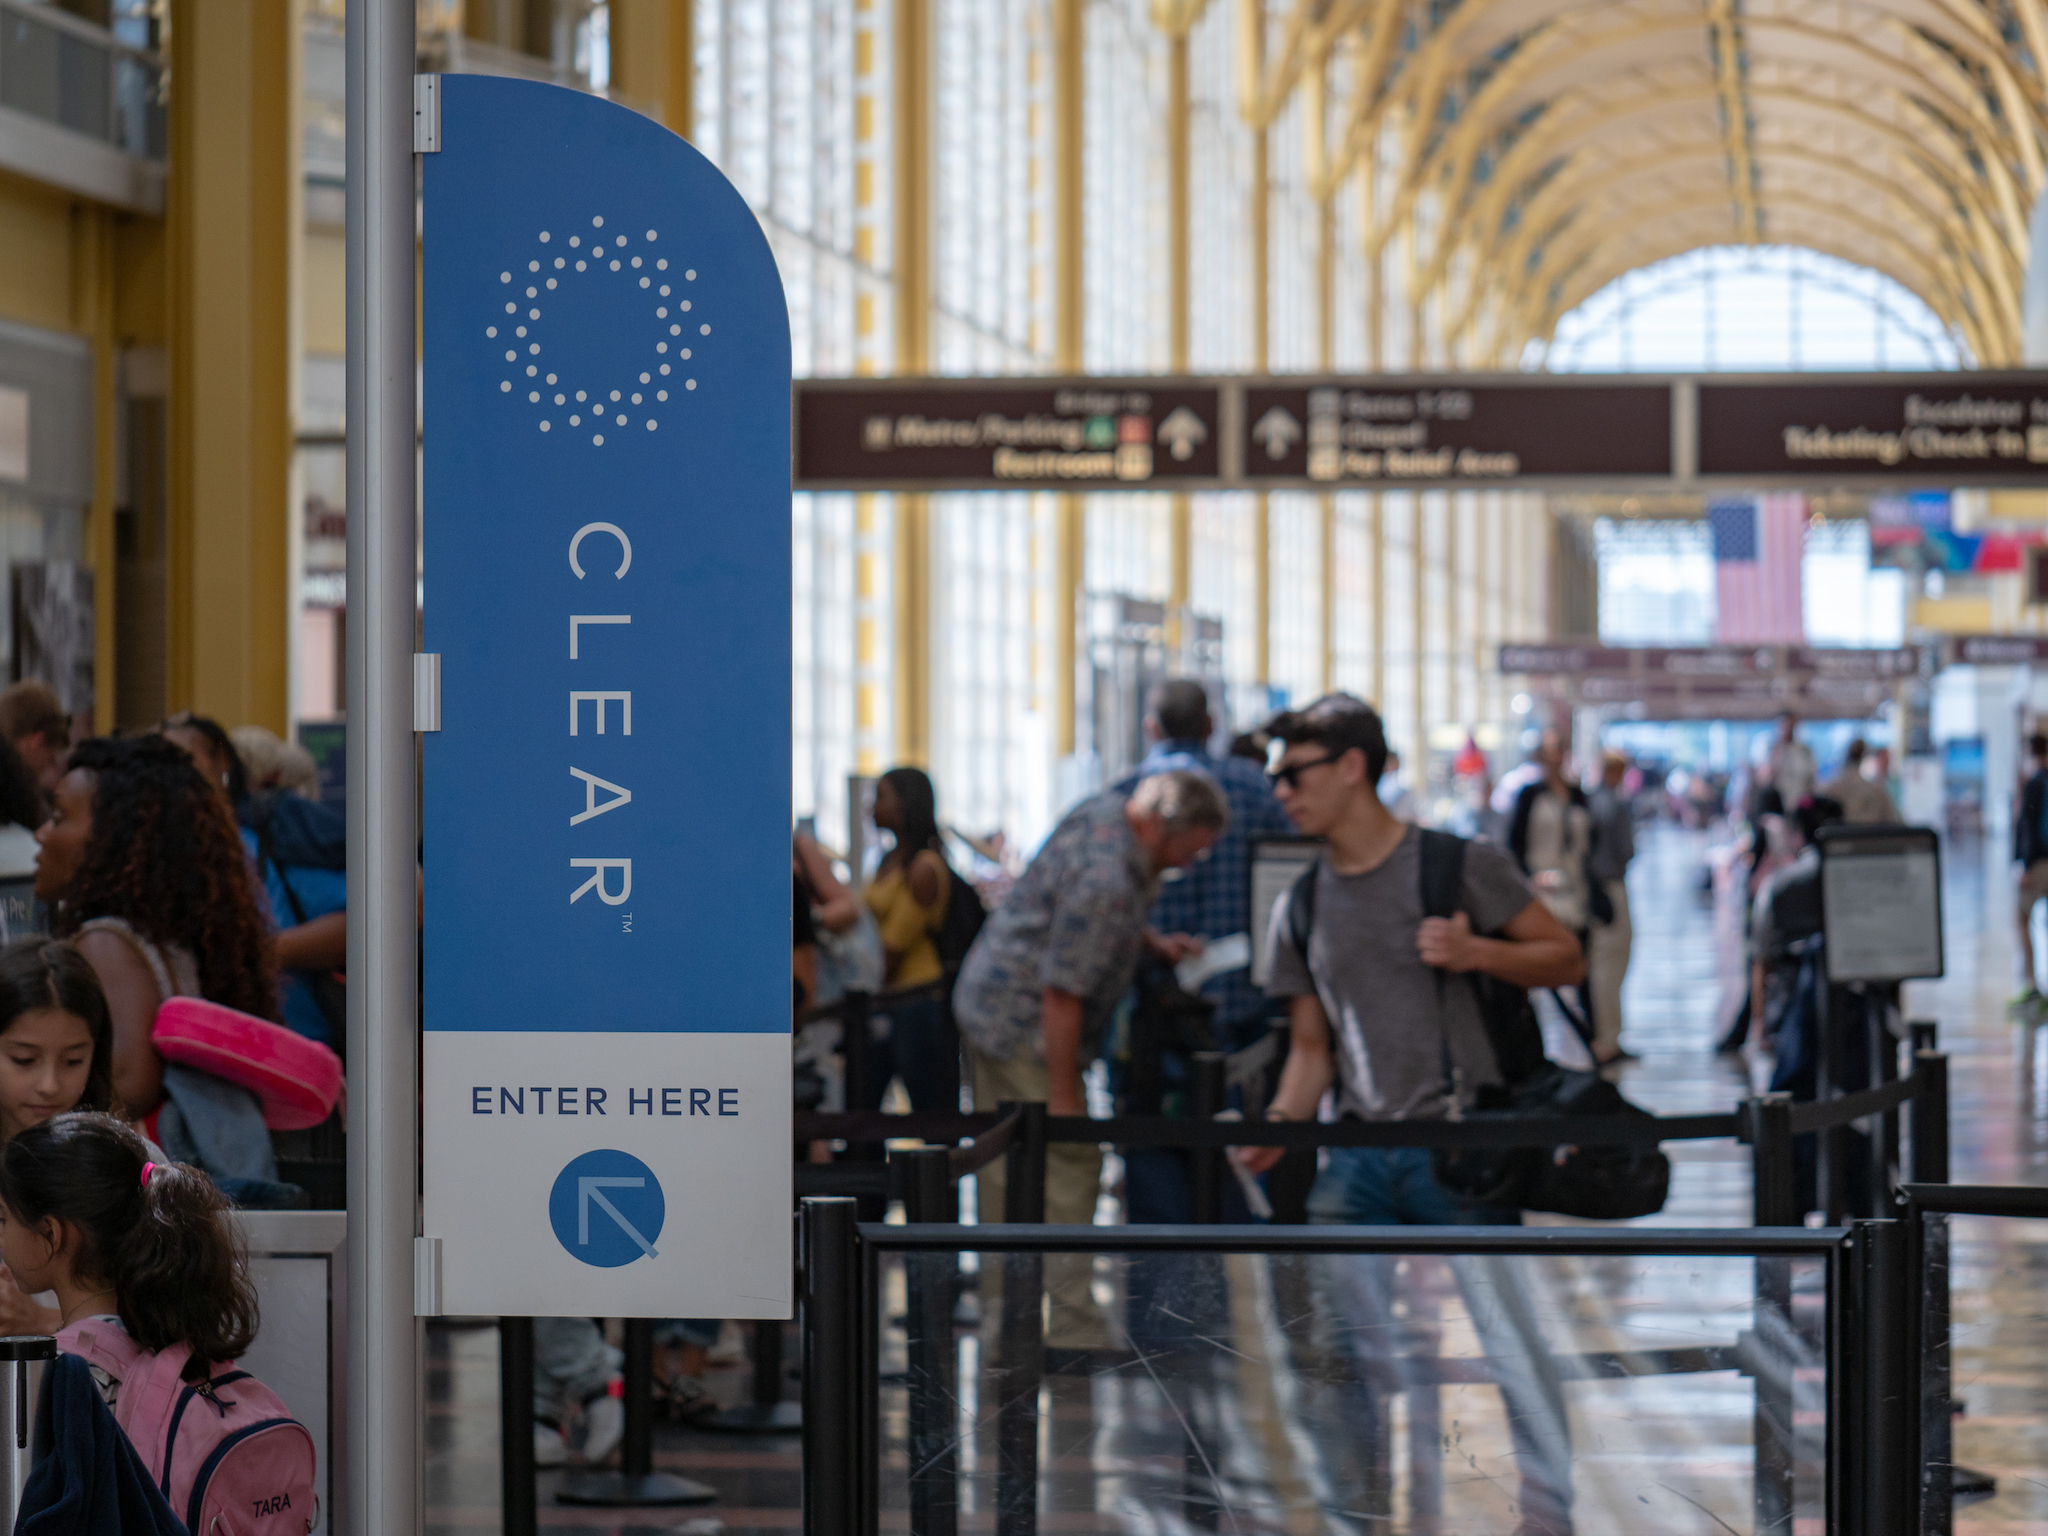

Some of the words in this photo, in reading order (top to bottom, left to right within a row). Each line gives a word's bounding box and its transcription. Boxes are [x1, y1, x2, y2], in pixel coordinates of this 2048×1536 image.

[568, 521, 633, 906] CLEAR
[472, 1086, 608, 1115] ENTER
[628, 1087, 739, 1116] HERE
[252, 1492, 292, 1518] TARA
